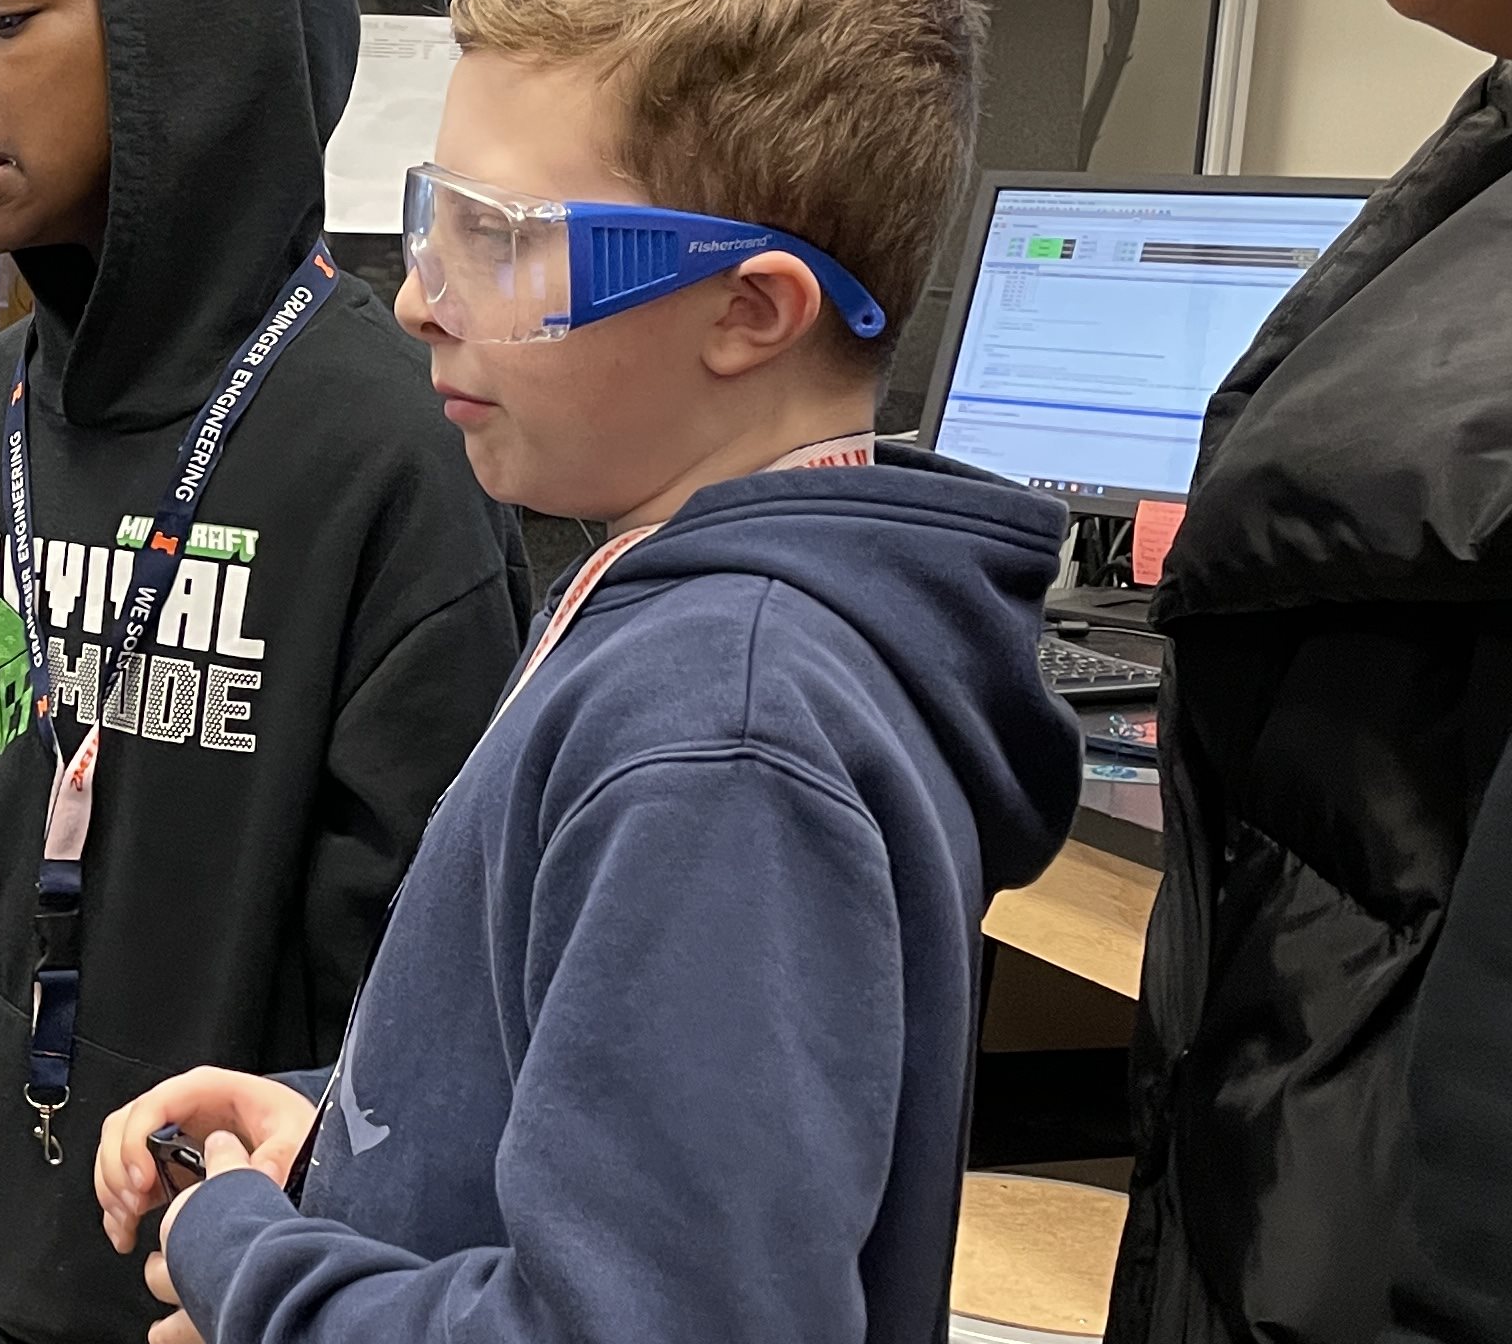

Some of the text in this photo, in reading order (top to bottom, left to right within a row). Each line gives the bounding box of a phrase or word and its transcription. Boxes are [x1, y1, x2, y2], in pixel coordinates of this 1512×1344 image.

[688, 236, 769, 253] Fisherbrand
[175, 286, 313, 502] GRAINGER ENGINEERING
[9, 430, 31, 564] ENGINEERING
[116, 515, 259, 561] MIRAFT
[130, 587, 157, 621] WE
